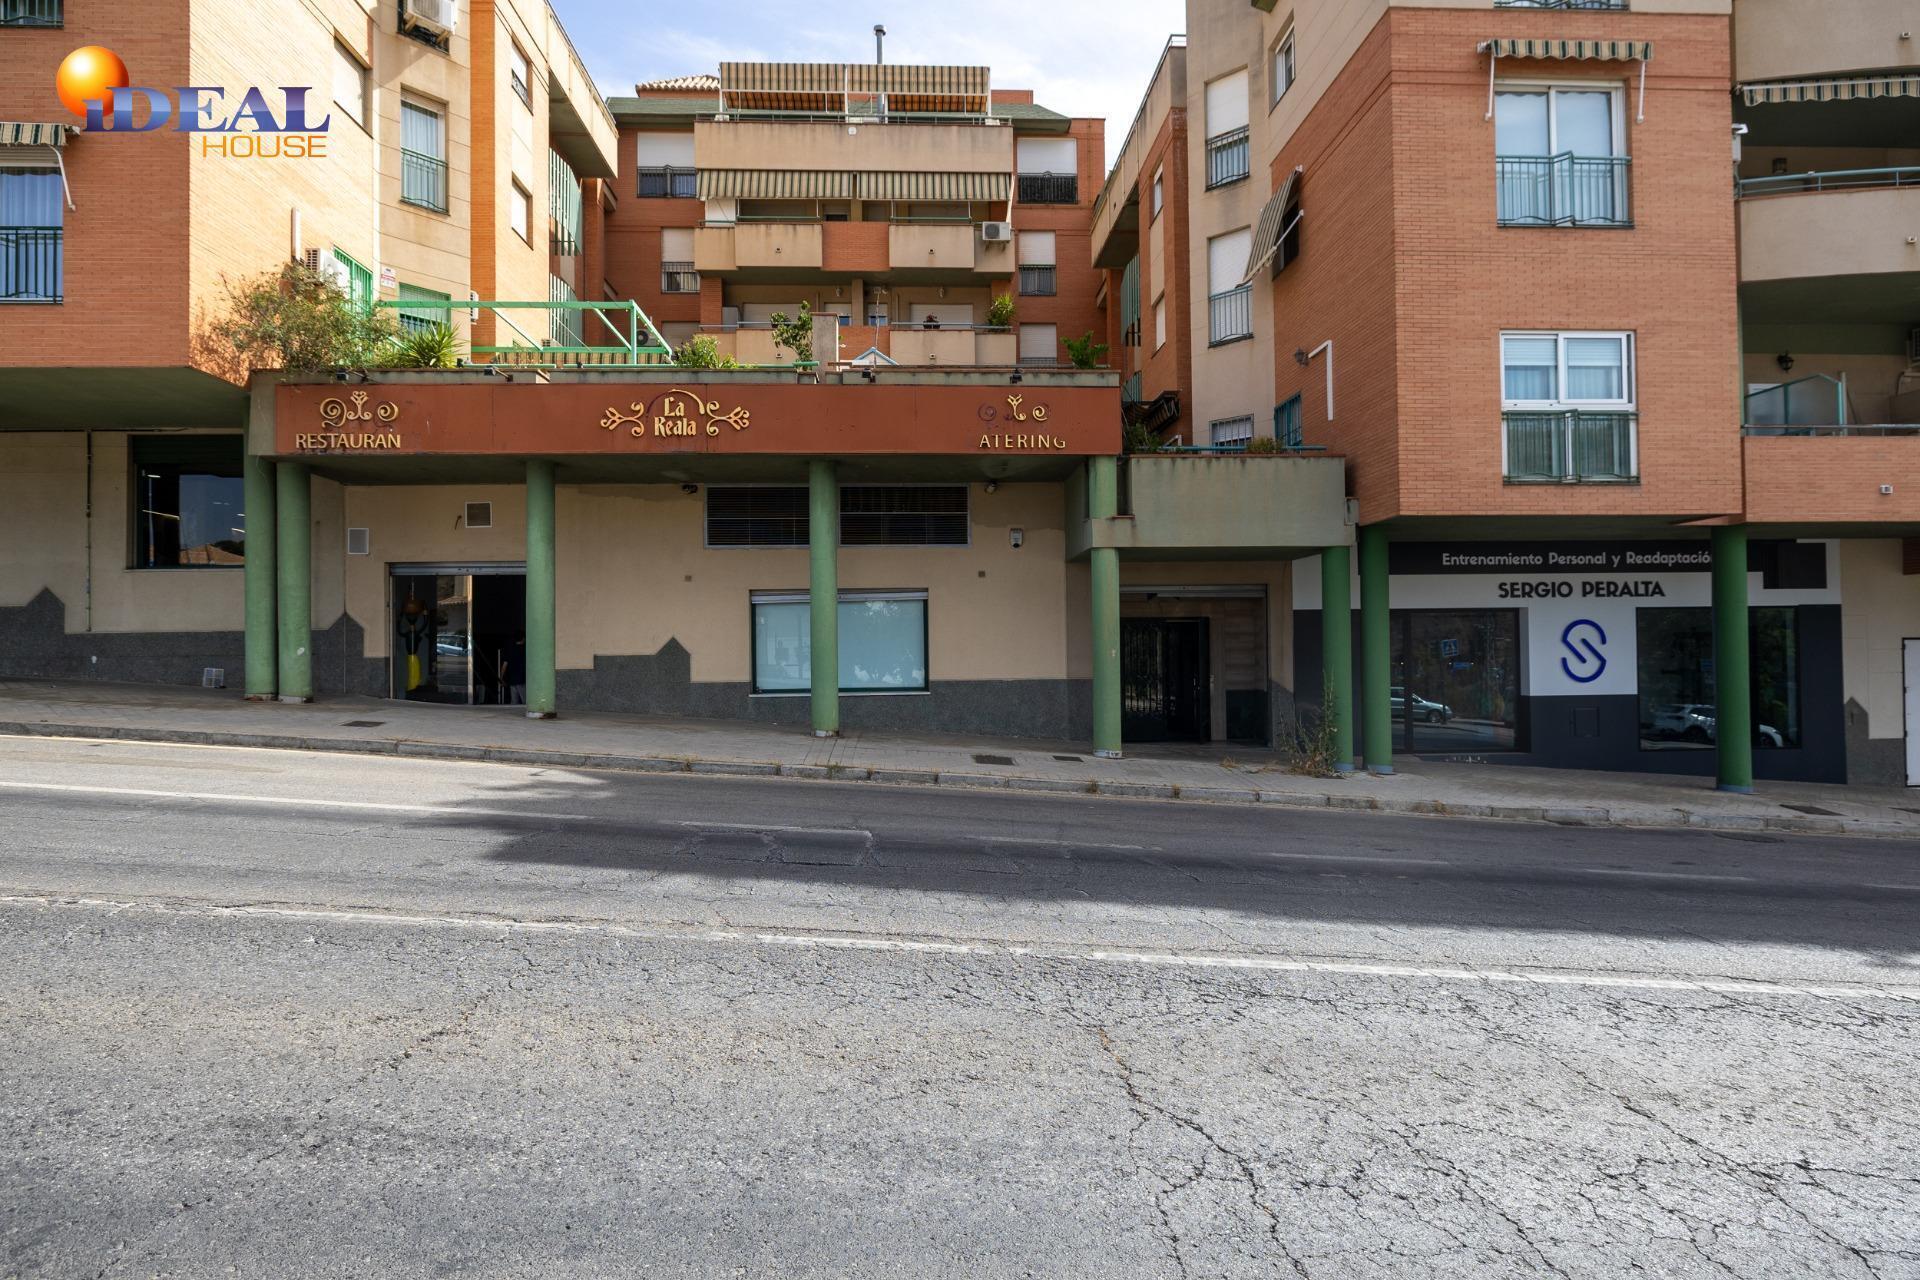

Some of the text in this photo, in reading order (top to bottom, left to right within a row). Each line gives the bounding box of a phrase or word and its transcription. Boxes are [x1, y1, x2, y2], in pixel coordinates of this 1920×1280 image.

[664, 396, 685, 417] La
[654, 416, 697, 437] Reala
[295, 433, 401, 449] RESTAURAN
[979, 434, 1066, 449] ATERING
[1442, 551, 1712, 568] Entrenamiento Personal y Readaptació
[1498, 581, 1665, 598] SERGIO PERALTA
